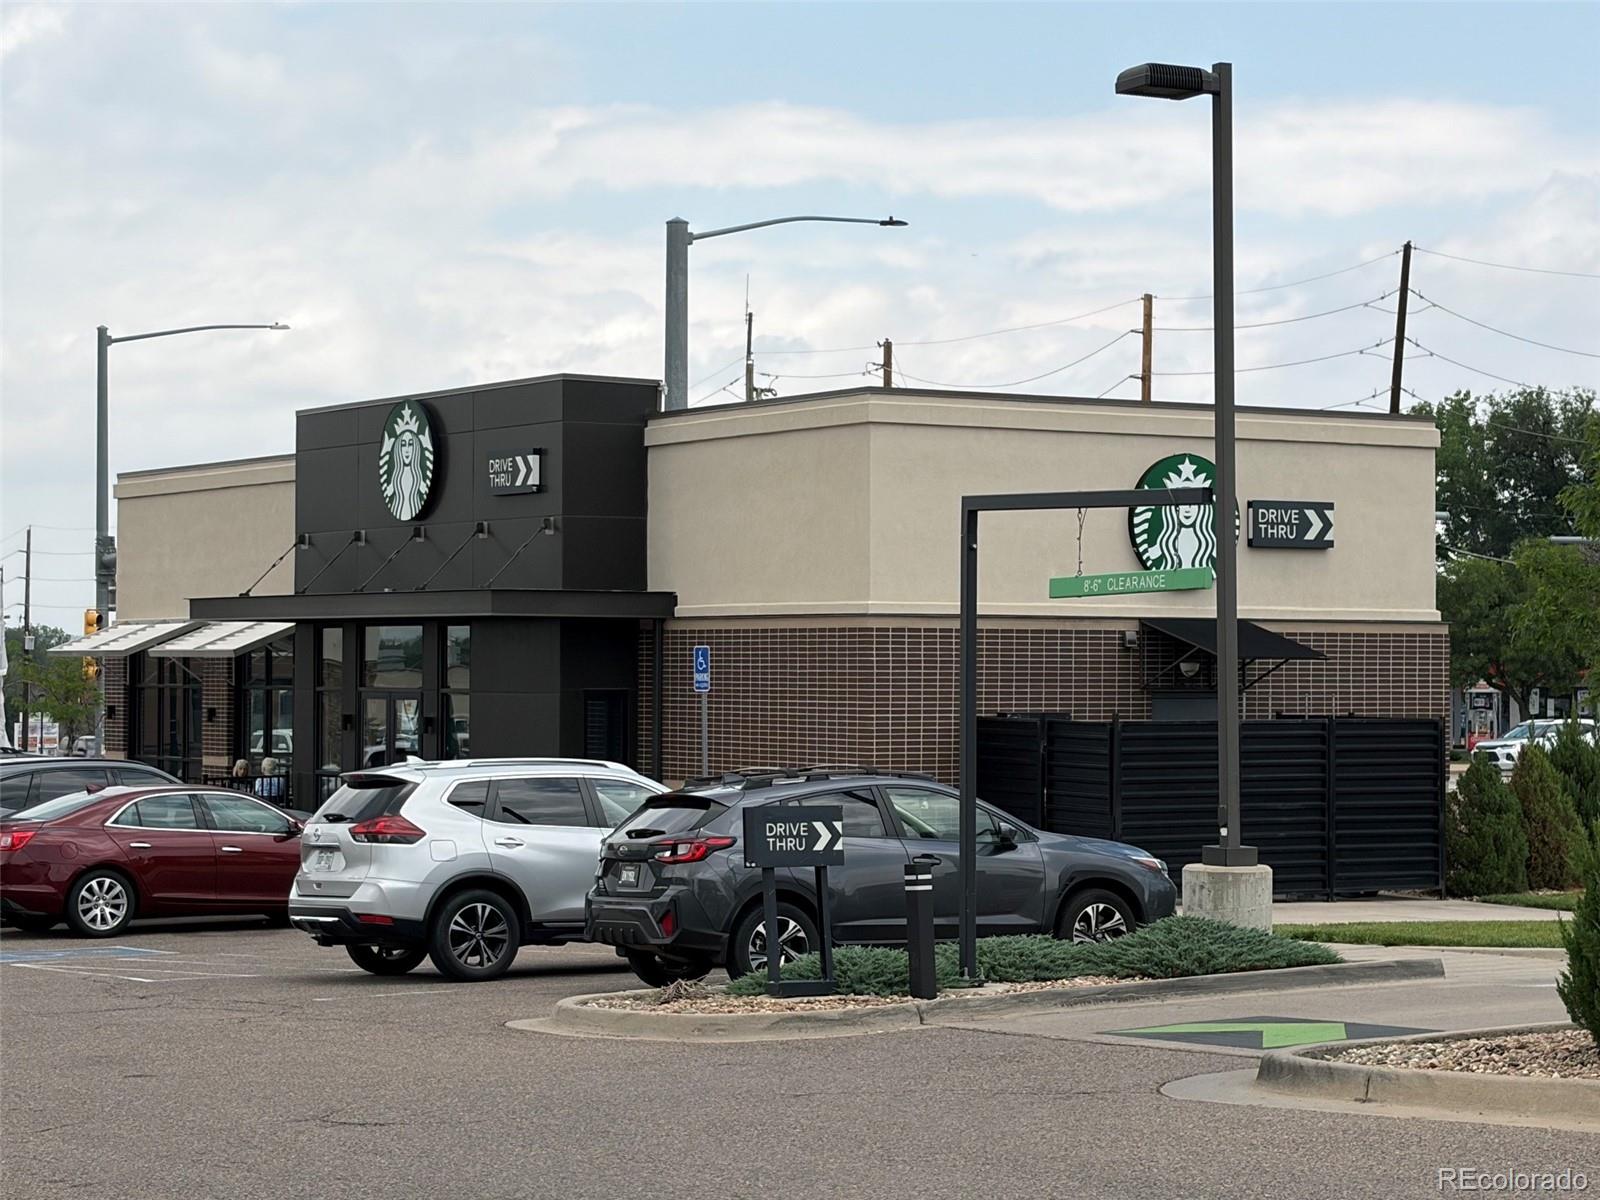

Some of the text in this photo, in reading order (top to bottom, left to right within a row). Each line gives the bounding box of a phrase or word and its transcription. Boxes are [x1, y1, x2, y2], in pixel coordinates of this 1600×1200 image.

[489, 457, 513, 473] DRIVE
[489, 473, 512, 488] THRU
[1258, 508, 1300, 524] DRIVE
[1258, 524, 1297, 540] THRU
[1107, 574, 1167, 591] CLEARANCE
[765, 822, 809, 836] DRIVE
[766, 837, 806, 851] THRU
